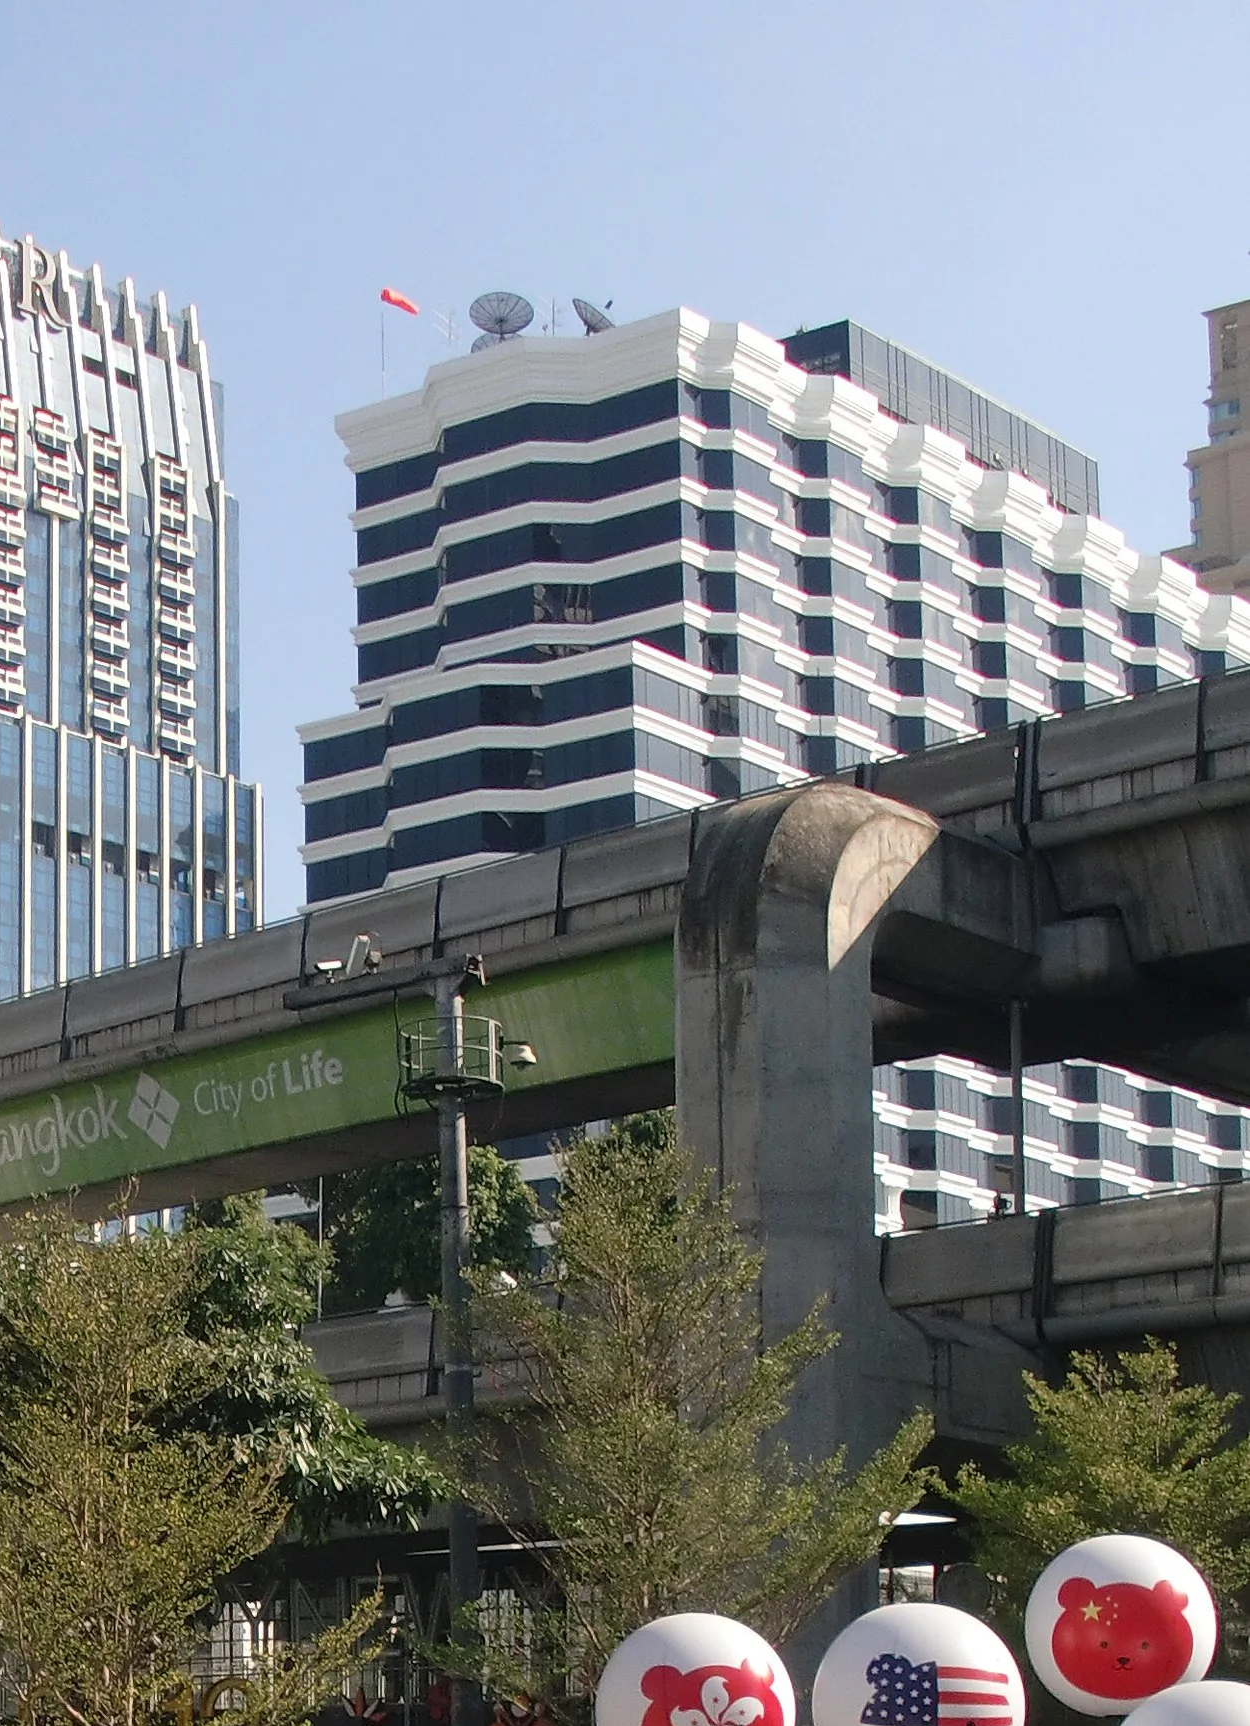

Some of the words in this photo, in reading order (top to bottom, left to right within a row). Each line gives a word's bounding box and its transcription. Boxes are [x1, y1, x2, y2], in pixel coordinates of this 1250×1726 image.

[14, 240, 72, 327] R
[194, 1079, 242, 1118] City
[252, 1061, 277, 1102] of
[282, 1050, 343, 1095] Life
